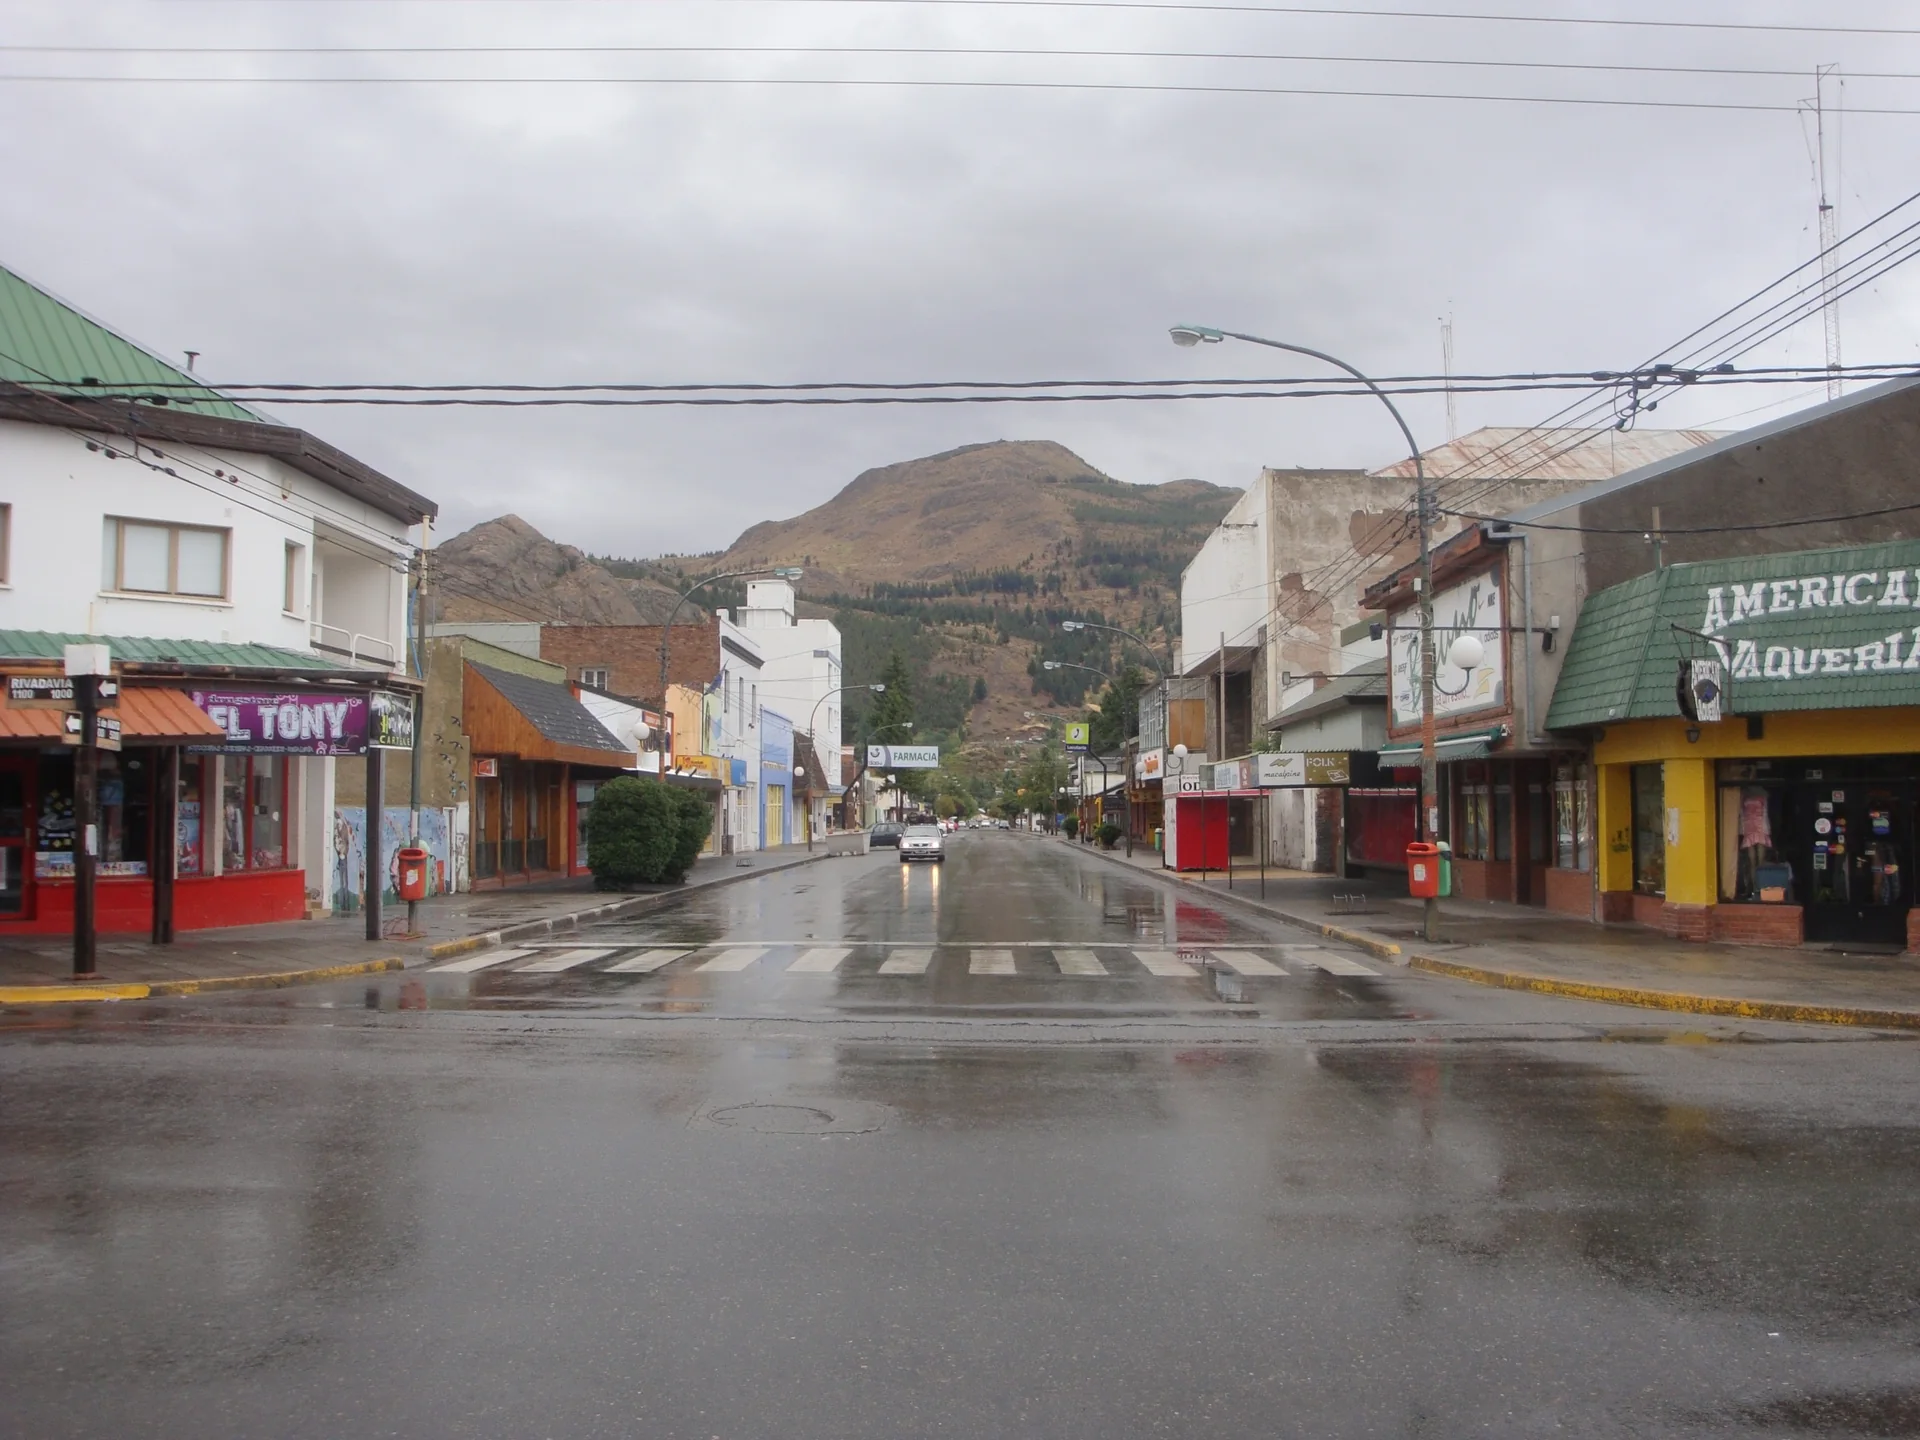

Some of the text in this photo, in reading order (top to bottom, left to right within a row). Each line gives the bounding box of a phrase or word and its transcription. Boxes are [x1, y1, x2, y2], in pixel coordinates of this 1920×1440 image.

[1701, 570, 1920, 635] AMERICA
[11, 678, 74, 688] RIVADAVIA
[12, 688, 74, 699] 1100 1000
[208, 705, 251, 740] EL
[258, 702, 348, 740] TONY
[893, 752, 938, 761] FARMACIA
[1306, 757, 1336, 768] FOLK
